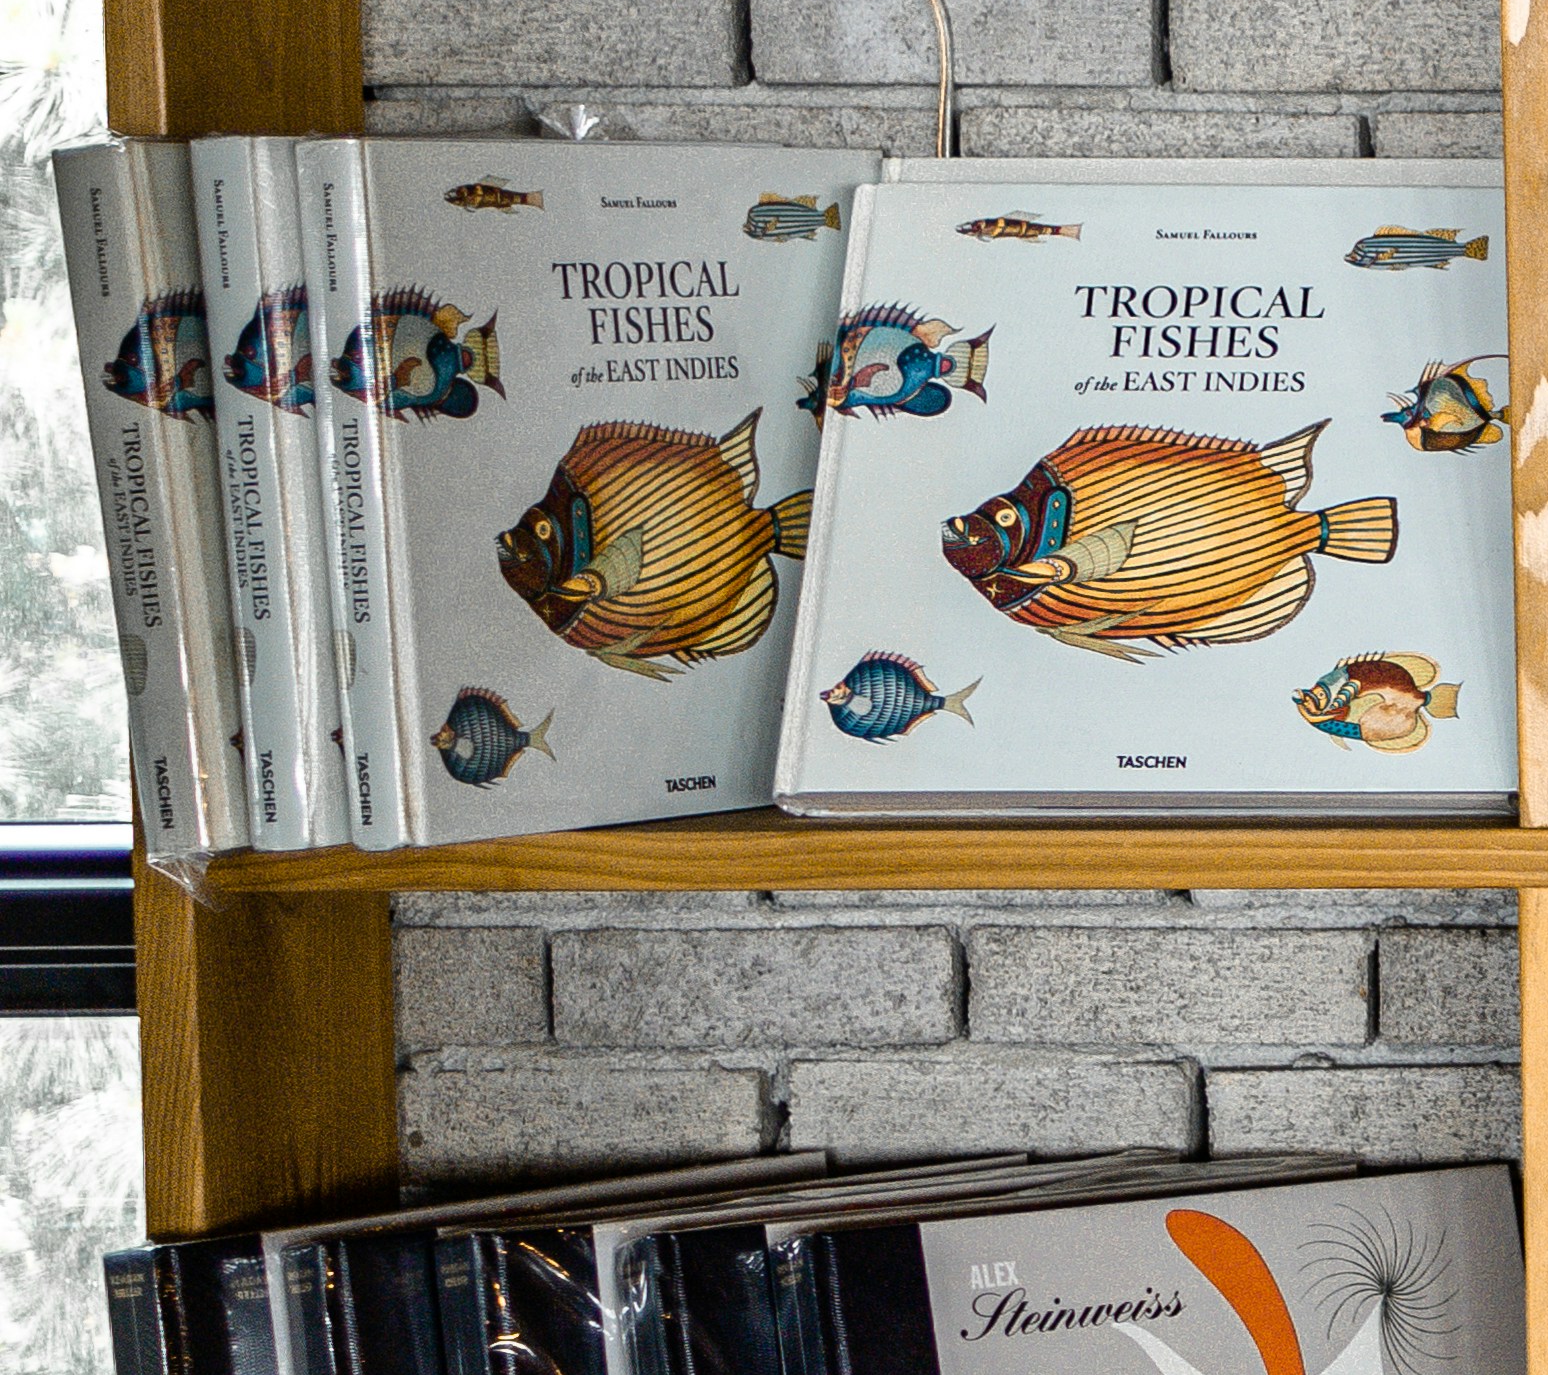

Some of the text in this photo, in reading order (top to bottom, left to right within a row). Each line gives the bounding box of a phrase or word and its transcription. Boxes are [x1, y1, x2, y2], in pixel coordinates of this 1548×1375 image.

[1074, 284, 1326, 320] TROPICAL
[1109, 325, 1281, 360] FISHES
[1074, 370, 1307, 395] of the EAST INDIES
[1116, 755, 1188, 770] TASCHEN
[970, 1260, 1019, 1291] ALEX
[960, 1286, 1186, 1342] Steinweiss
